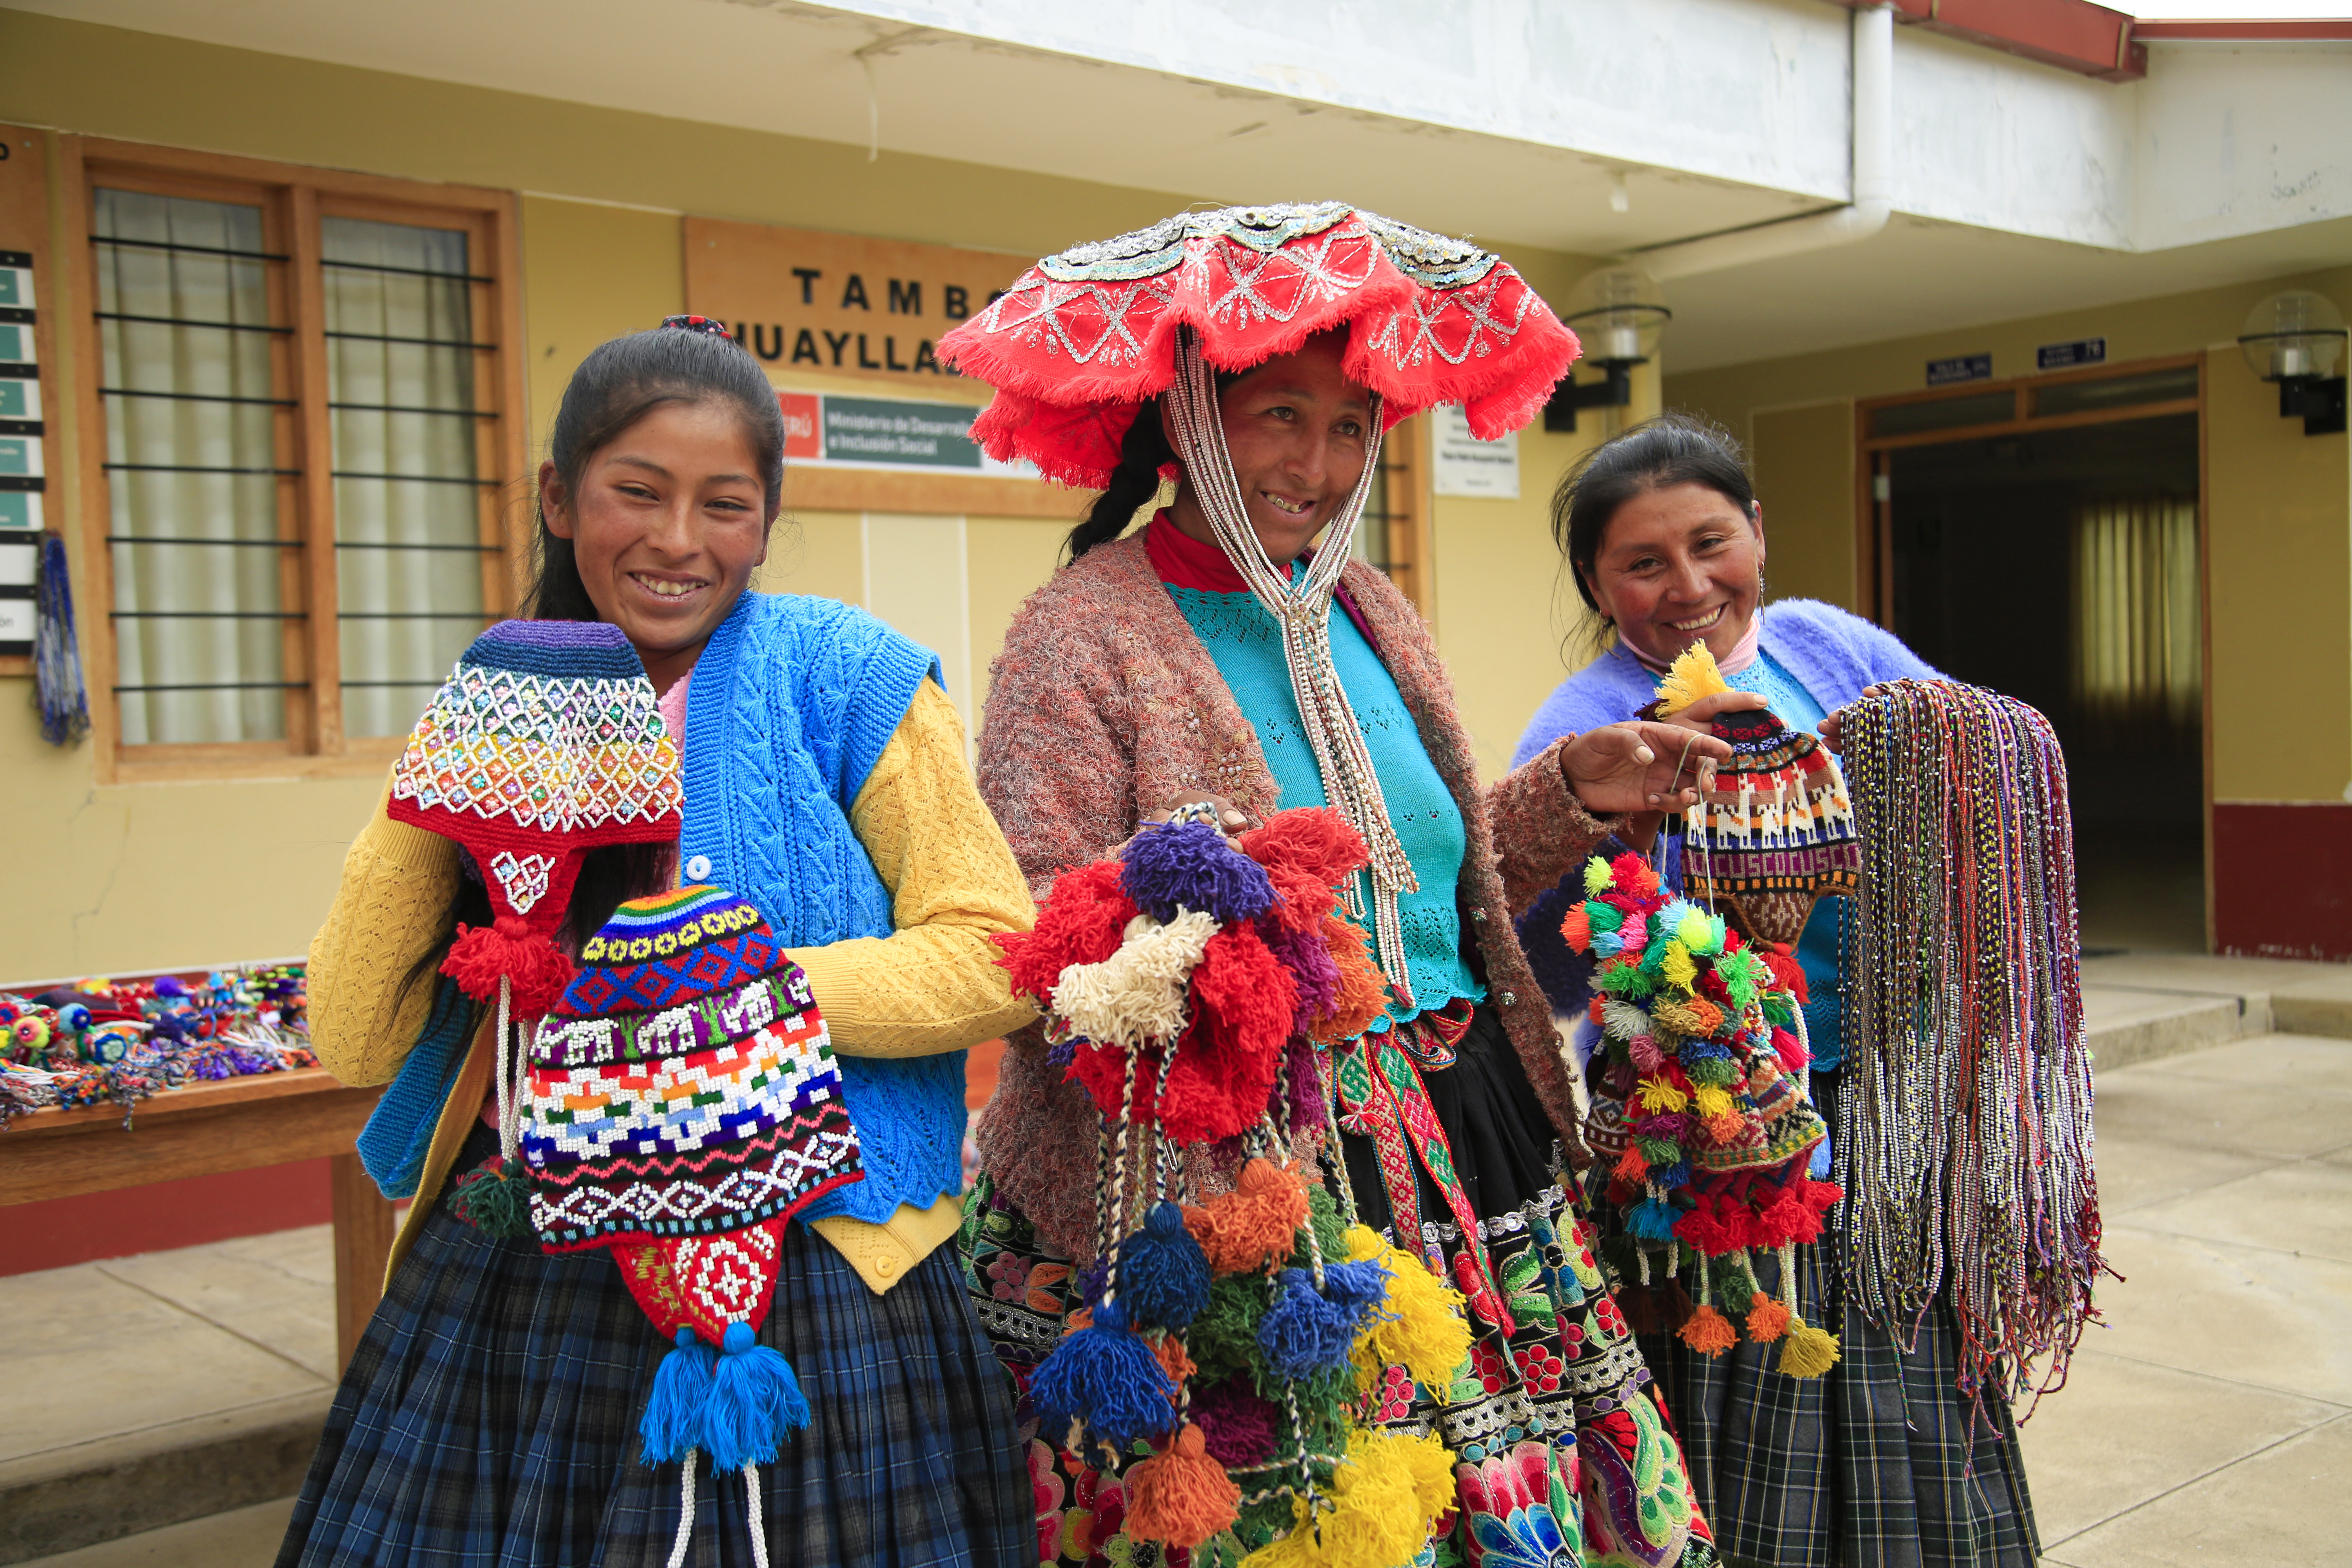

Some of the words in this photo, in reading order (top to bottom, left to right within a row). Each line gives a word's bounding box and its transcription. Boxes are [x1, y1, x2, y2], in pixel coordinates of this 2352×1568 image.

[717, 321, 964, 375] UAYLLA
[783, 412, 813, 438] ERÚ
[828, 412, 892, 433] Ministerio
[893, 416, 909, 434] de
[909, 416, 969, 438] Desarroll
[829, 435, 837, 448] e
[839, 432, 897, 454] Inclusión
[898, 435, 938, 457] Social
